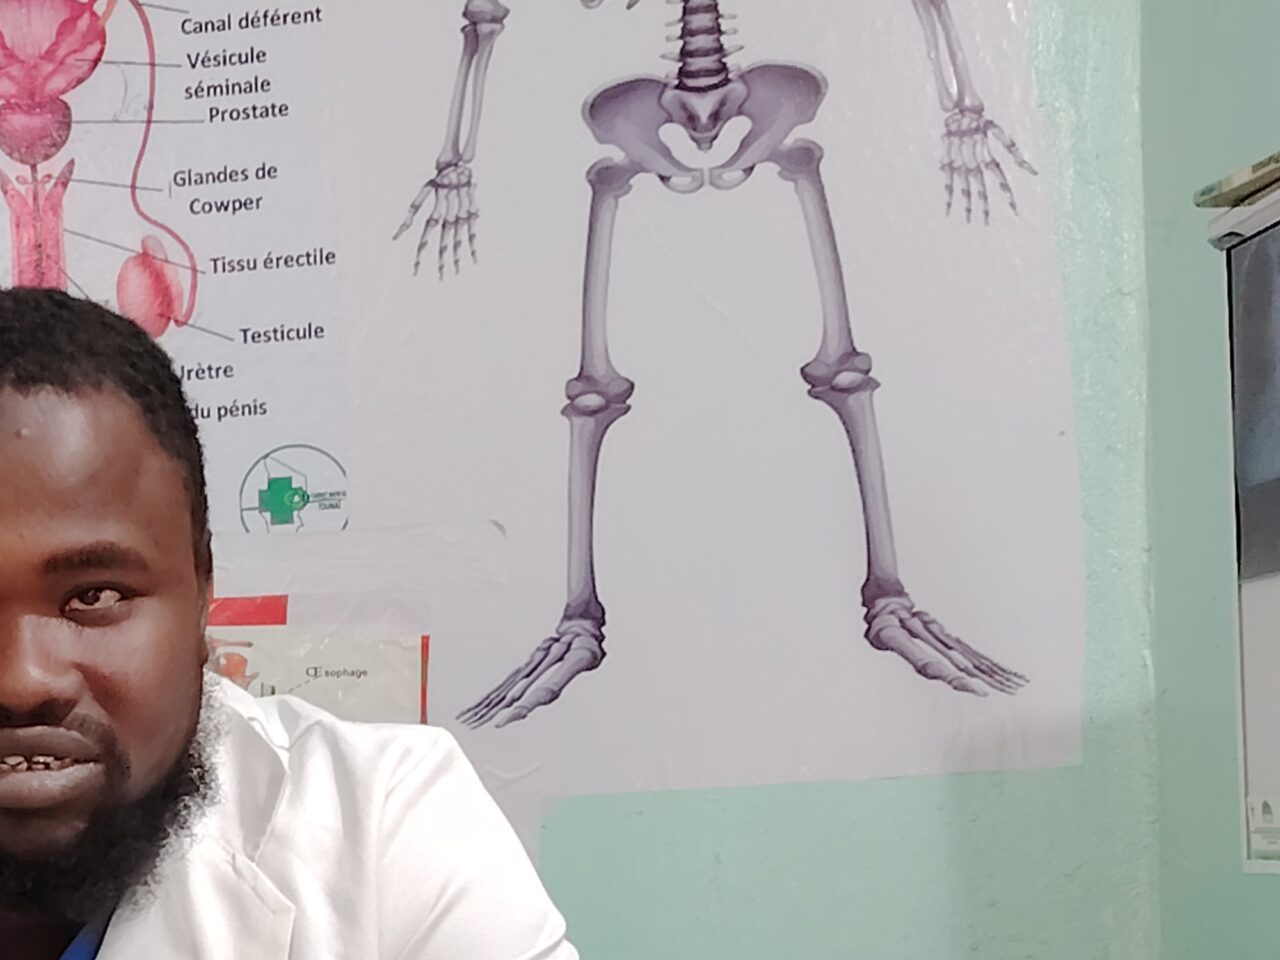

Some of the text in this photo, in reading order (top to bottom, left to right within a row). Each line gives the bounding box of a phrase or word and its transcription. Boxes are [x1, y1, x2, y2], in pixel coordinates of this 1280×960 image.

[181, 8, 321, 34] Canal déférent
[187, 47, 266, 69] Vésicule
[185, 76, 270, 99] séminale
[210, 103, 288, 122] Prostate
[173, 163, 277, 187] Glandes de
[190, 197, 262, 215] Cowper
[210, 248, 335, 274] Tissu érectile
[240, 323, 324, 344] Testicule
[217, 398, 267, 422] pénis
